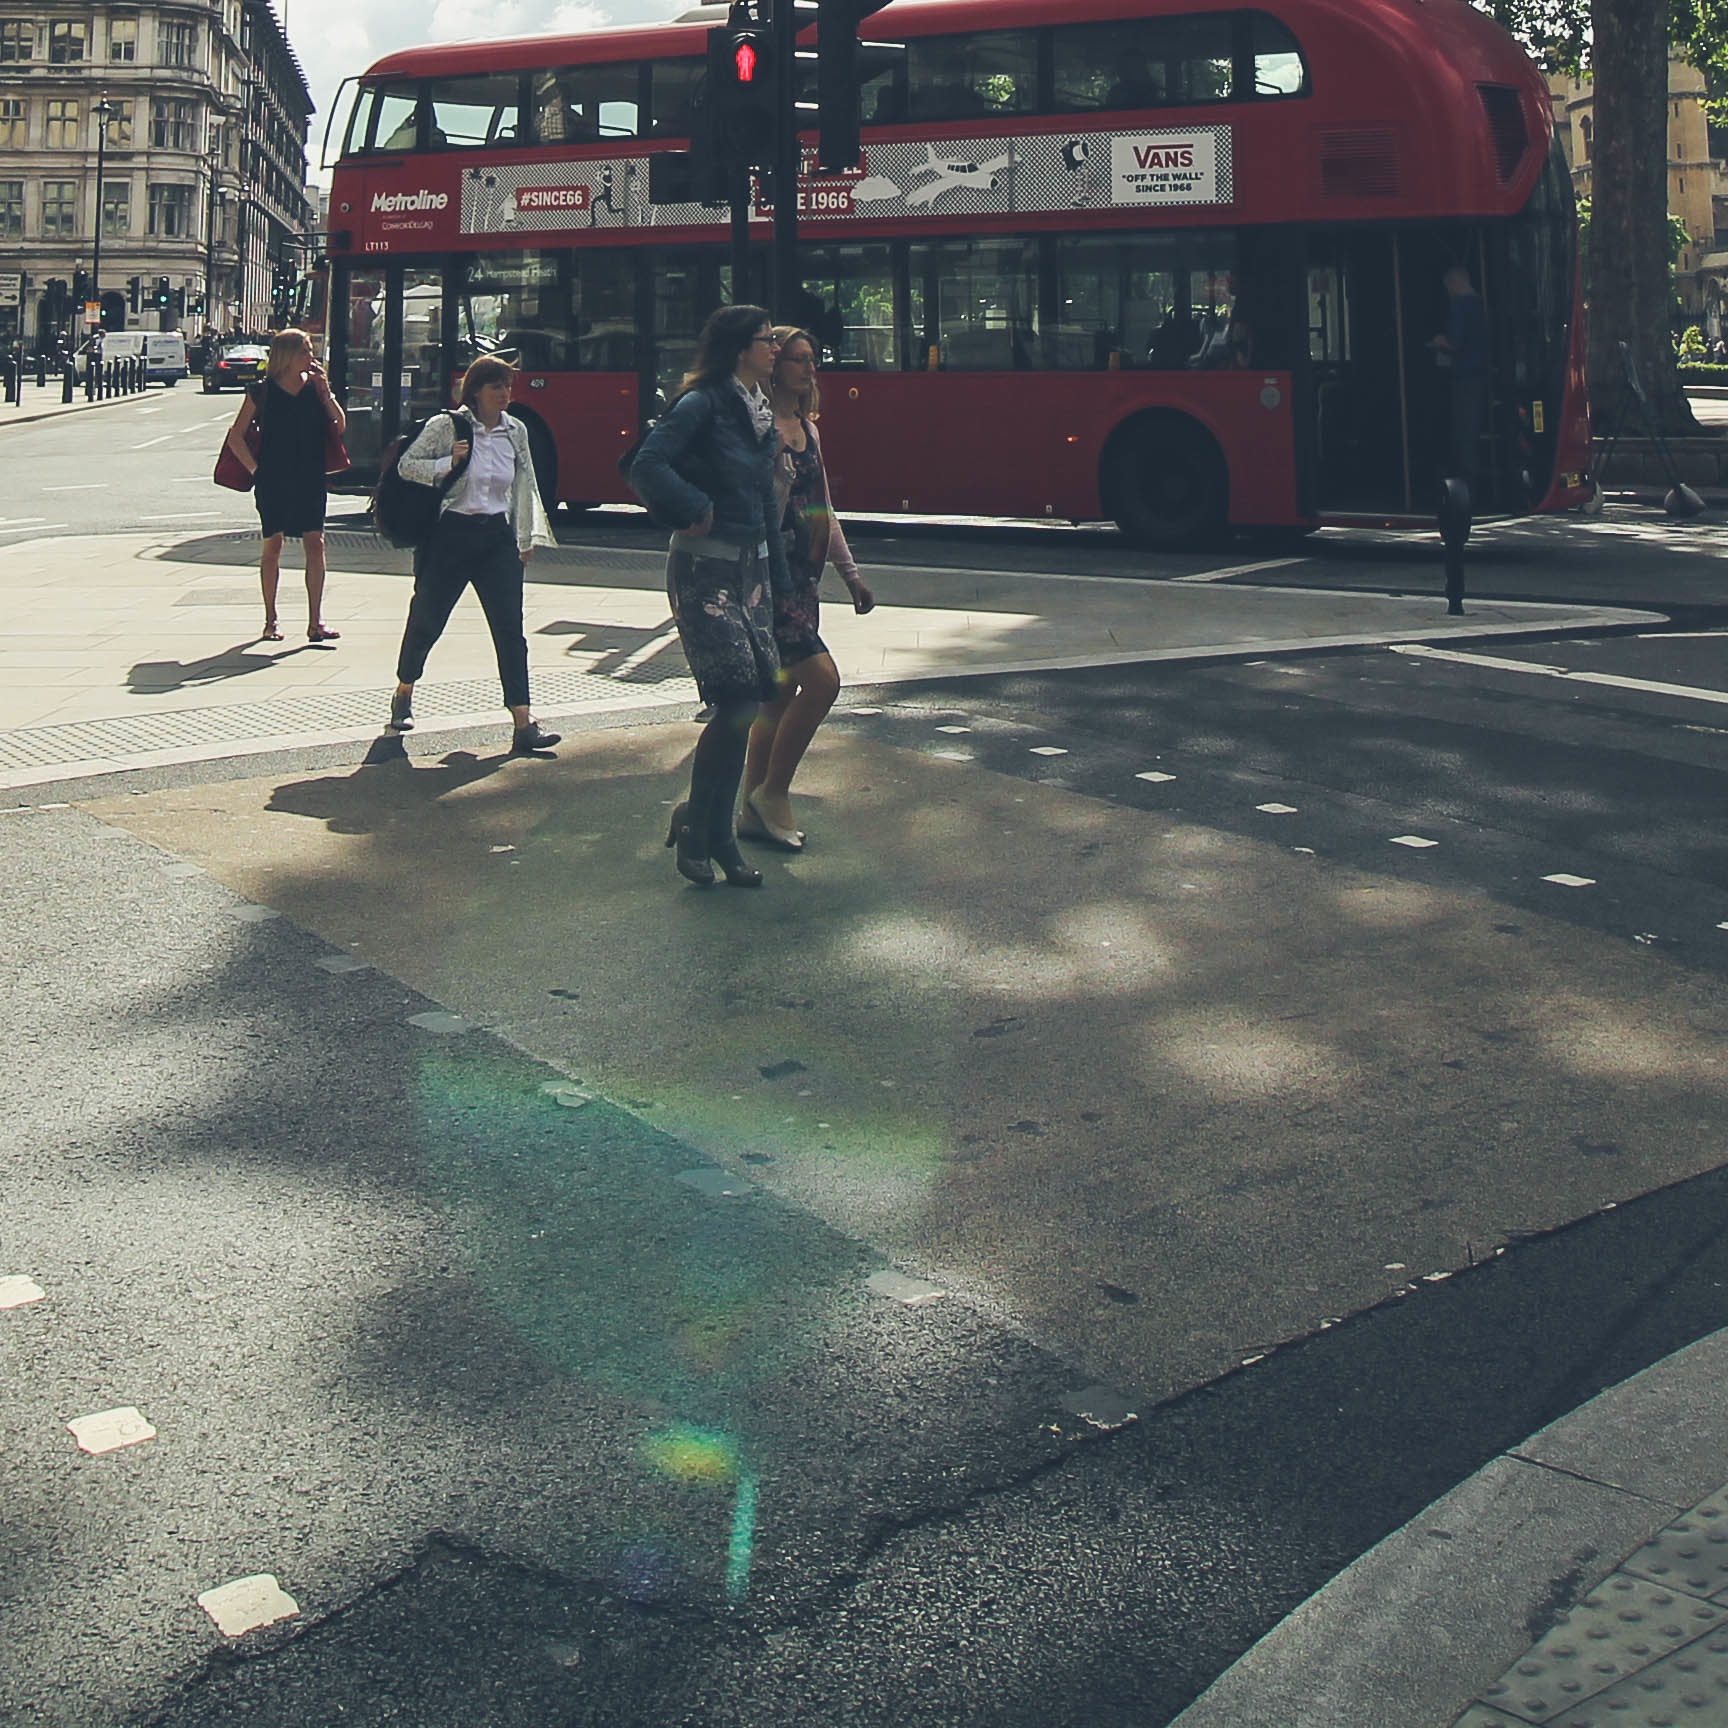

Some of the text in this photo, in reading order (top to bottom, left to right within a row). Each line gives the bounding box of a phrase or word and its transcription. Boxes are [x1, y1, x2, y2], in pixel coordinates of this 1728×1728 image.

[1133, 144, 1193, 169] VANS
[1150, 173, 1170, 182] THE
[1135, 183, 1192, 193] SINCE 1966
[370, 189, 449, 213] Metroline
[520, 190, 583, 206] #SINCE66
[810, 192, 848, 210] 1966
[365, 241, 390, 252] LT113
[467, 265, 484, 283] 24
[485, 268, 529, 280] Hampstead
